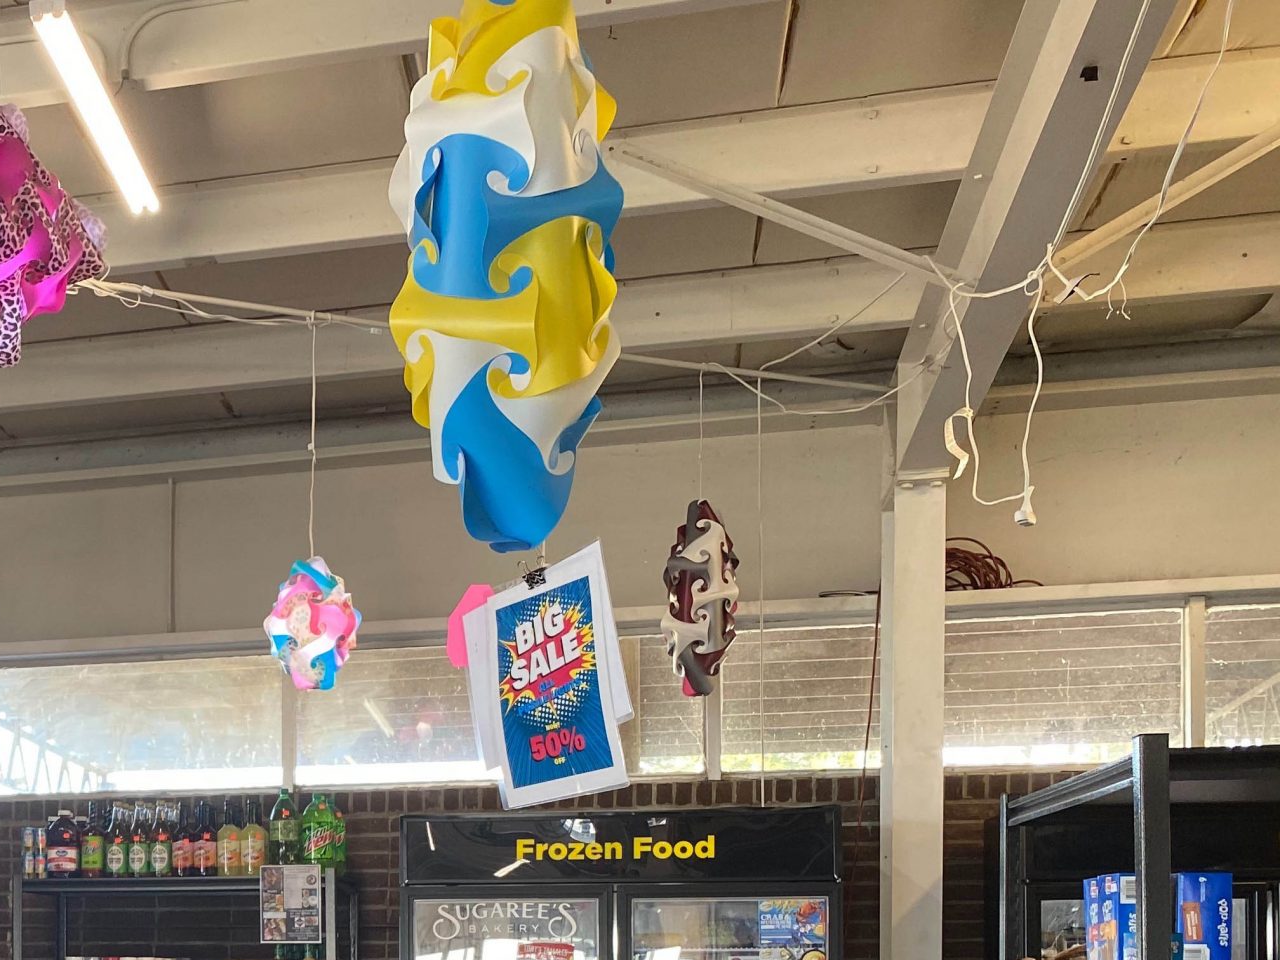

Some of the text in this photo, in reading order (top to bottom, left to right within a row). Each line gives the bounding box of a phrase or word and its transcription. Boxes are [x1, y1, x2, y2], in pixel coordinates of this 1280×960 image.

[515, 602, 565, 656] BIG
[510, 629, 582, 690] SALE
[529, 726, 587, 761] 50%
[516, 834, 716, 861] Frozen Food
[432, 902, 577, 940] SUGAREE'S
[469, 924, 540, 934] BAKERY
